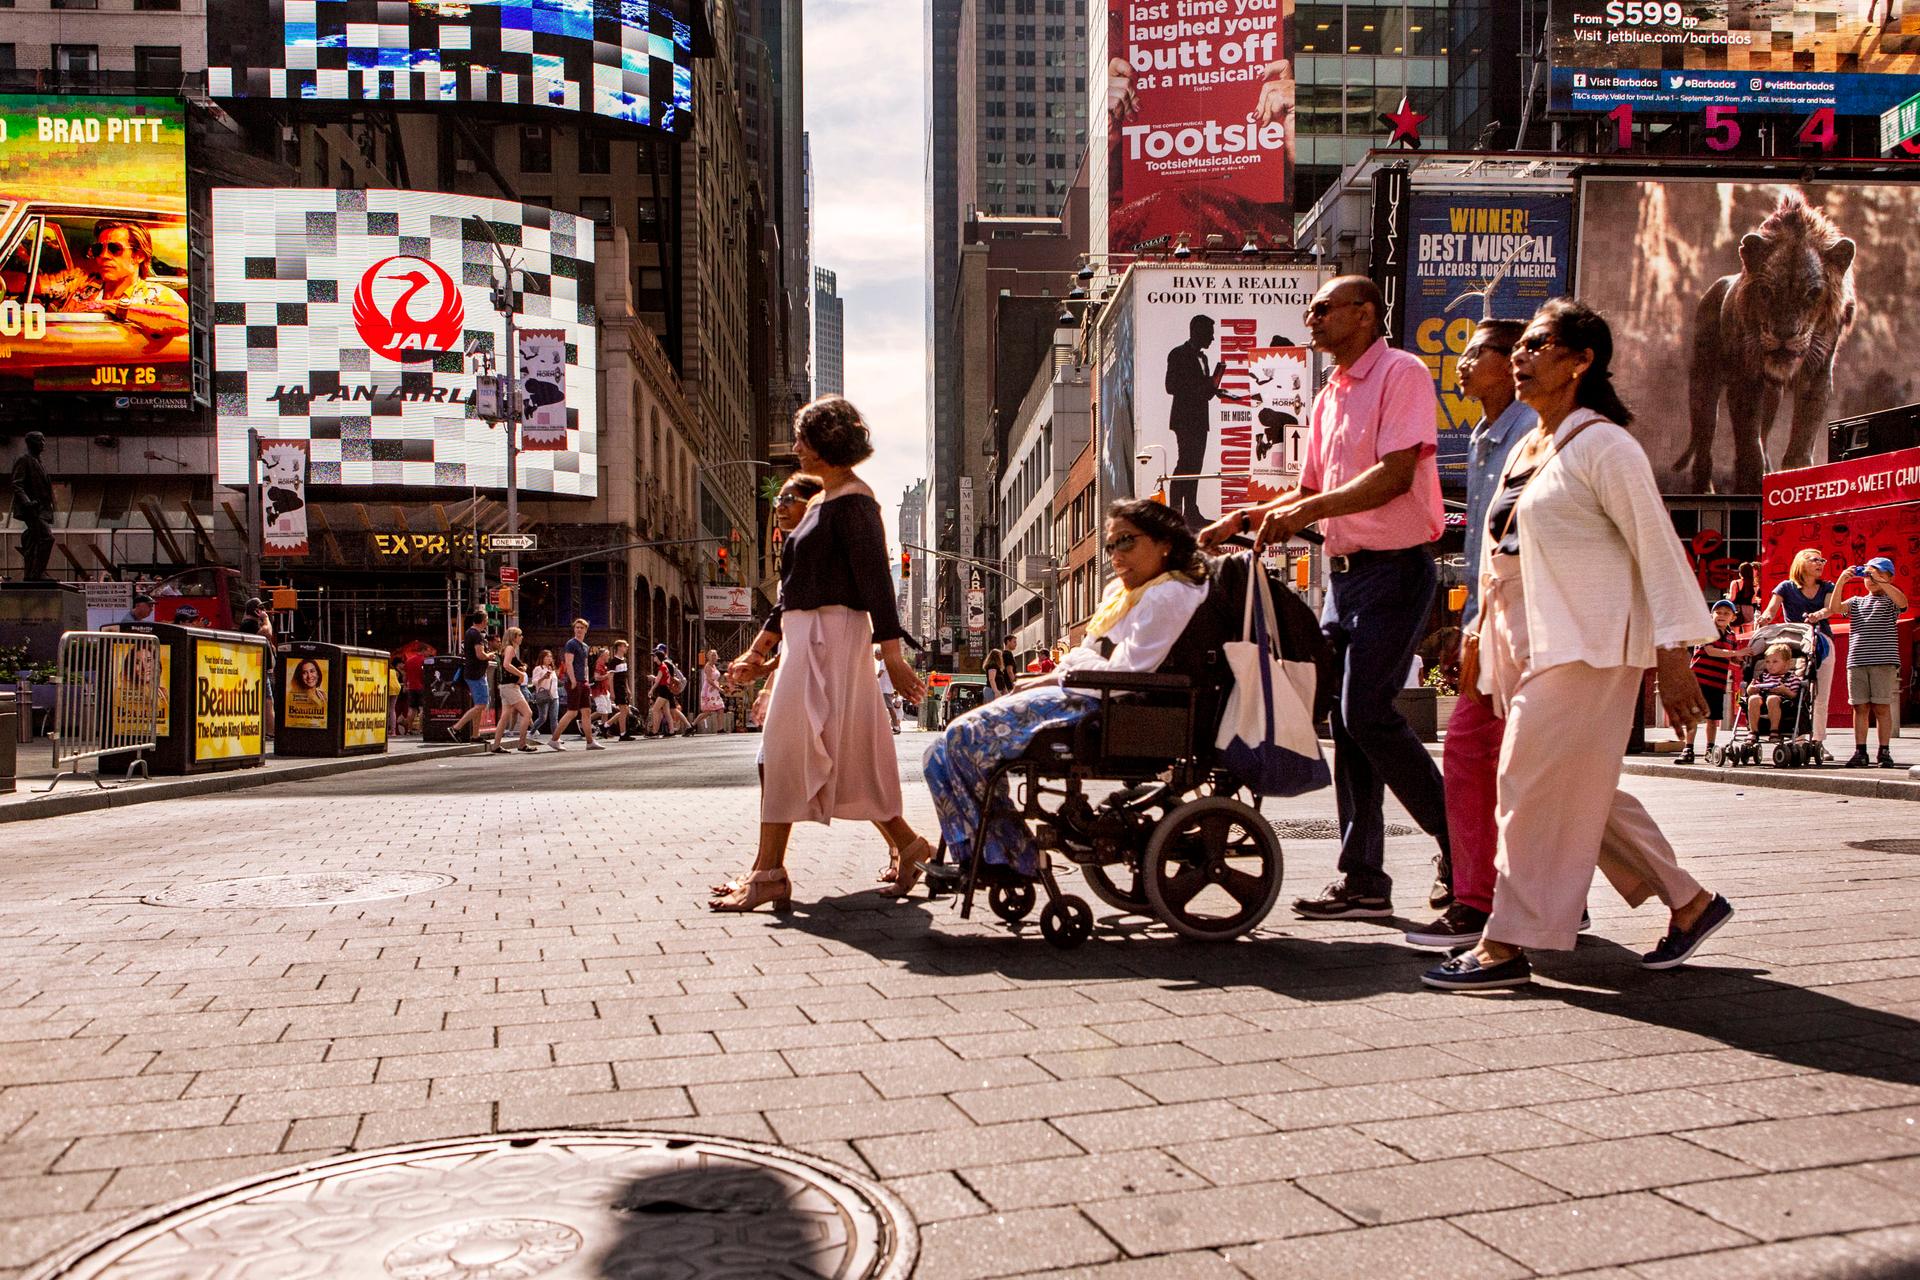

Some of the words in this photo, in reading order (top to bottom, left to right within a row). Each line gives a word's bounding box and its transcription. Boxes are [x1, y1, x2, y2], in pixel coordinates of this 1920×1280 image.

[1130, 4, 1169, 21] last
[1177, 0, 1229, 17] time
[1234, 0, 1277, 15] you
[1573, 14, 1602, 24] From
[1606, 0, 1682, 26] $599
[1130, 17, 1220, 41] laughed
[1225, 16, 1277, 36] your
[1574, 30, 1602, 41] Visit
[1606, 30, 1752, 45] jetblue.com/barbados
[1129, 40, 1212, 72] butt
[1219, 32, 1277, 64] off
[1136, 74, 1156, 90] at
[1162, 76, 1173, 88] a
[1590, 77, 1611, 87] Visit
[1612, 78, 1658, 88] Barbados
[1684, 79, 1736, 88] @Barbados
[1765, 80, 1834, 90] @visitbarbados
[1610, 93, 1626, 101] Valid
[1655, 94, 1670, 102] June
[1680, 94, 1713, 104] September
[38, 117, 100, 142] BRAD
[107, 118, 162, 143] PITT
[1122, 112, 1284, 160] Tootsie
[1146, 154, 1261, 171] TootsieMusical.com
[1450, 207, 1529, 234] WINNER!
[1133, 236, 1168, 251] LAMAR
[1419, 234, 1467, 262] BEST
[1471, 235, 1556, 263] MUSICAL
[1417, 263, 1438, 276] ALL
[1438, 263, 1477, 277] ACROSS
[1514, 264, 1556, 278] AMERICA
[1173, 276, 1216, 289] HAVE
[1222, 276, 1233, 288] A
[1239, 277, 1300, 290] REALLY
[1147, 292, 1196, 304] GOOD
[1202, 292, 1244, 304] TIME
[1249, 293, 1315, 305] TONIGH
[382, 333, 443, 350] JAL
[1416, 317, 1478, 354] CO
[91, 367, 130, 385] JULY
[134, 368, 156, 384] 26
[266, 385, 379, 402] JAPAN
[385, 386, 479, 407] AIRLI
[1272, 400, 1306, 408] MORMON
[1221, 410, 1230, 422] THE
[1232, 410, 1252, 422] MUSIC
[1768, 480, 1849, 506] COFFEED
[1857, 471, 1894, 494] SWEET
[198, 676, 260, 717] Beautiful
[347, 683, 387, 714] Beautiful
[198, 722, 210, 738] The
[210, 722, 228, 738] Carole
[228, 722, 240, 740] King
[240, 721, 260, 736] Musical
[346, 718, 354, 730] The
